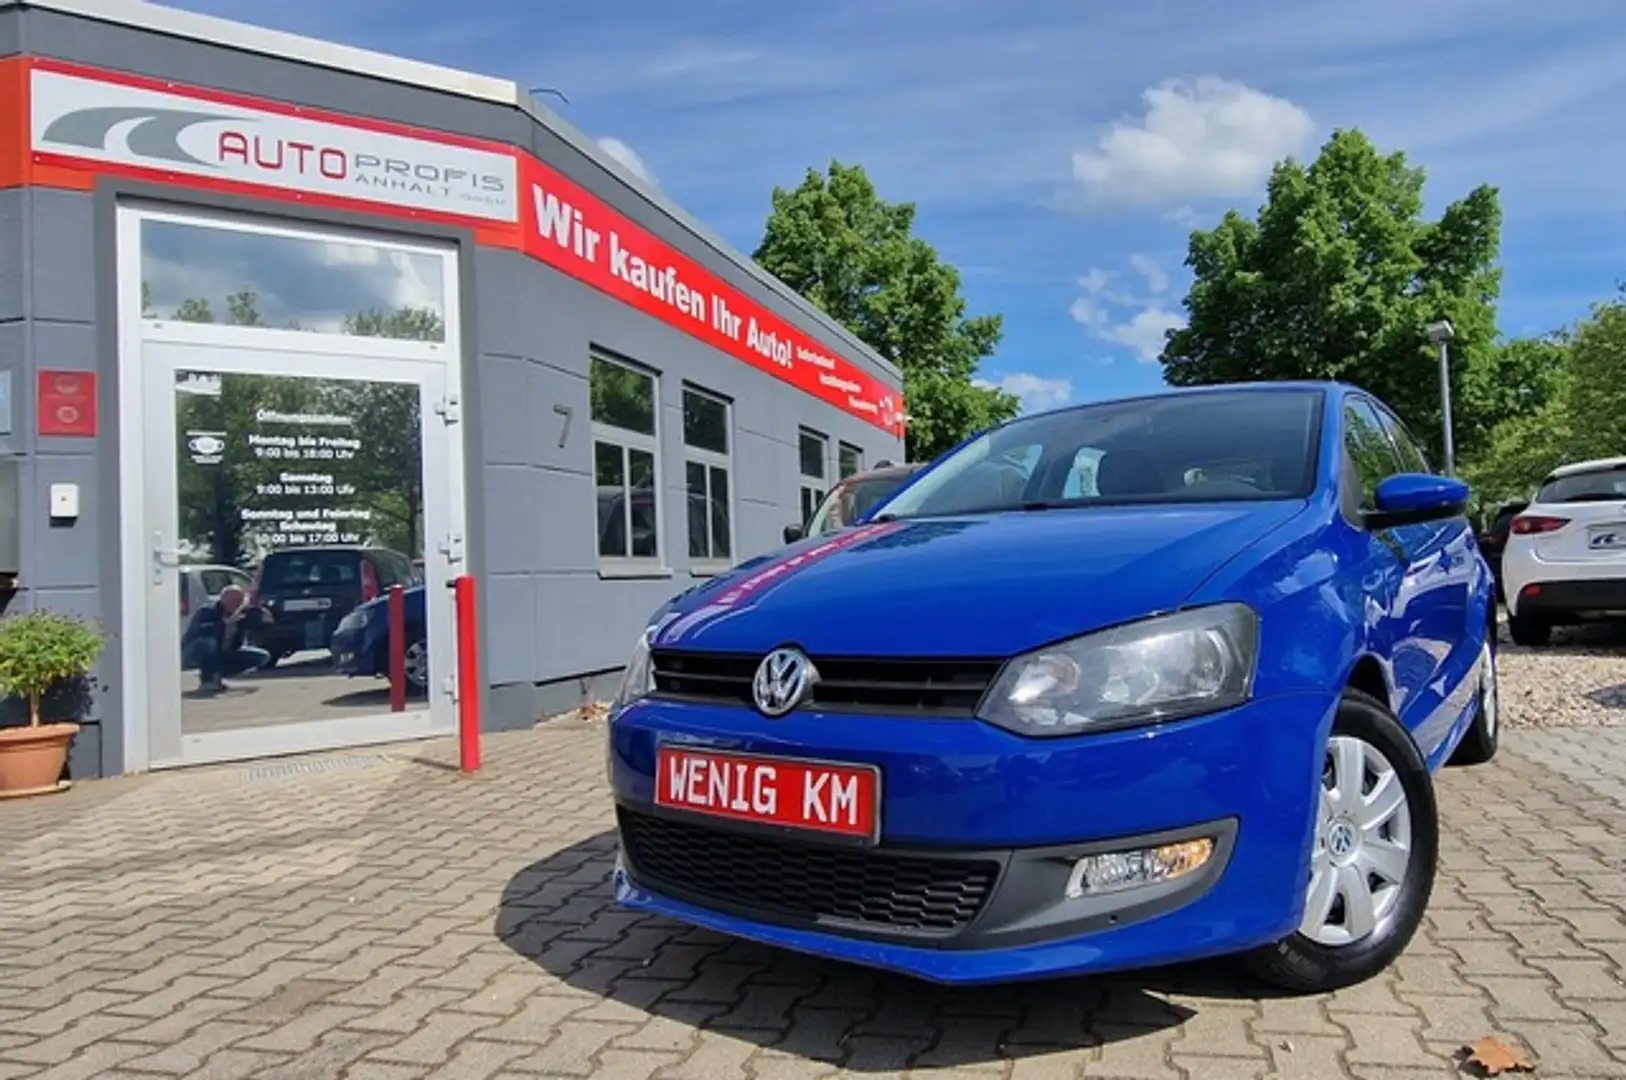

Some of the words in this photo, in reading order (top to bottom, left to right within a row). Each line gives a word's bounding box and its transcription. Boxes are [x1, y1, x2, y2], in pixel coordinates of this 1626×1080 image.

[219, 131, 347, 179] AUTO
[355, 154, 505, 192] PROFIS
[355, 174, 450, 196] ANHALT
[532, 183, 601, 263] Wir
[609, 231, 705, 323] kaufen
[711, 294, 742, 341] Ihr
[747, 316, 793, 369] Auto!
[553, 404, 573, 449] 7
[669, 755, 777, 815] WENIG
[802, 770, 858, 826] KM
